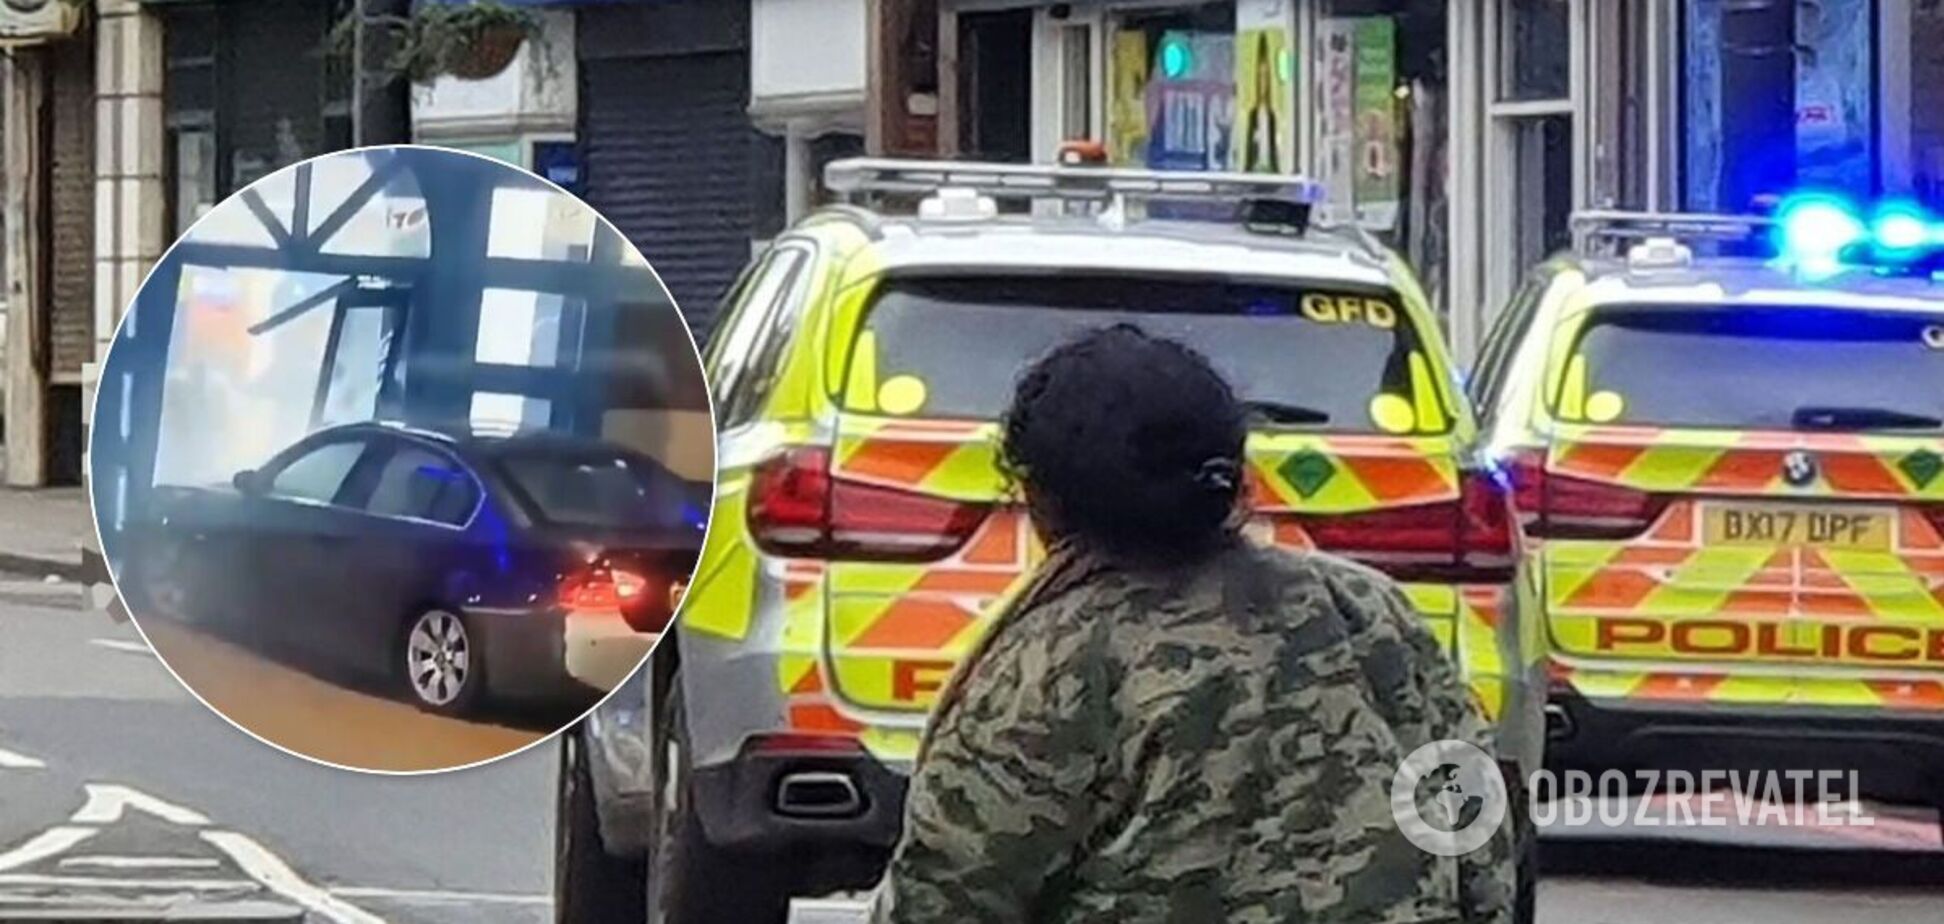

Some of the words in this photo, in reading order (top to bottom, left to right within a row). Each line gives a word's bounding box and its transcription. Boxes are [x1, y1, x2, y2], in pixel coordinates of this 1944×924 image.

[1301, 293, 1396, 328] GFD
[1724, 510, 1796, 541] BX17
[1807, 512, 1872, 542] DPF
